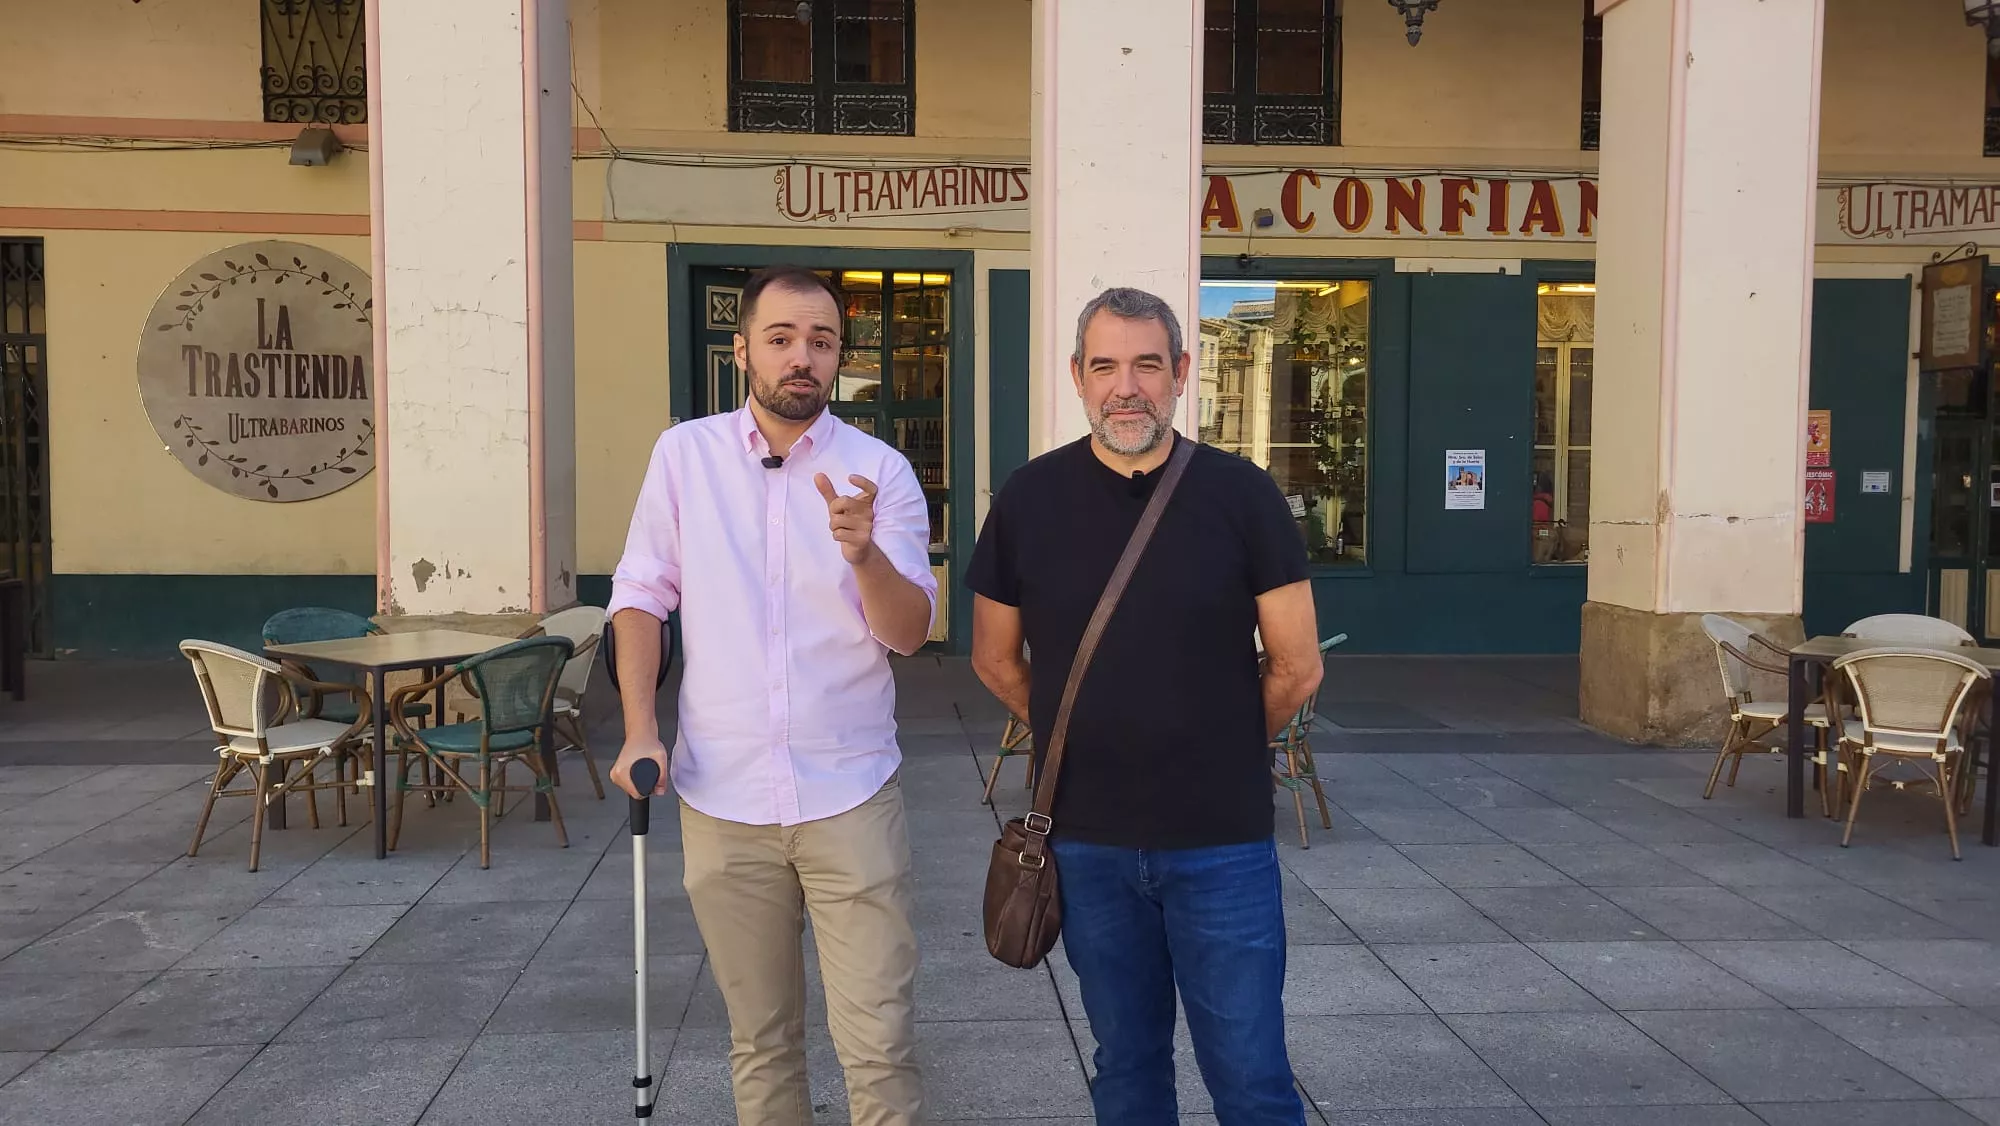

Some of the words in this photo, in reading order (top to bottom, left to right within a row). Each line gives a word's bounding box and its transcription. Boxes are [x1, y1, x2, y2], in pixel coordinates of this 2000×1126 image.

[785, 165, 1029, 217] ULTRAMARINOS
[256, 297, 294, 350] LA
[181, 344, 368, 400] TRASTIENDA
[228, 412, 345, 444] ULTRABARINOS
